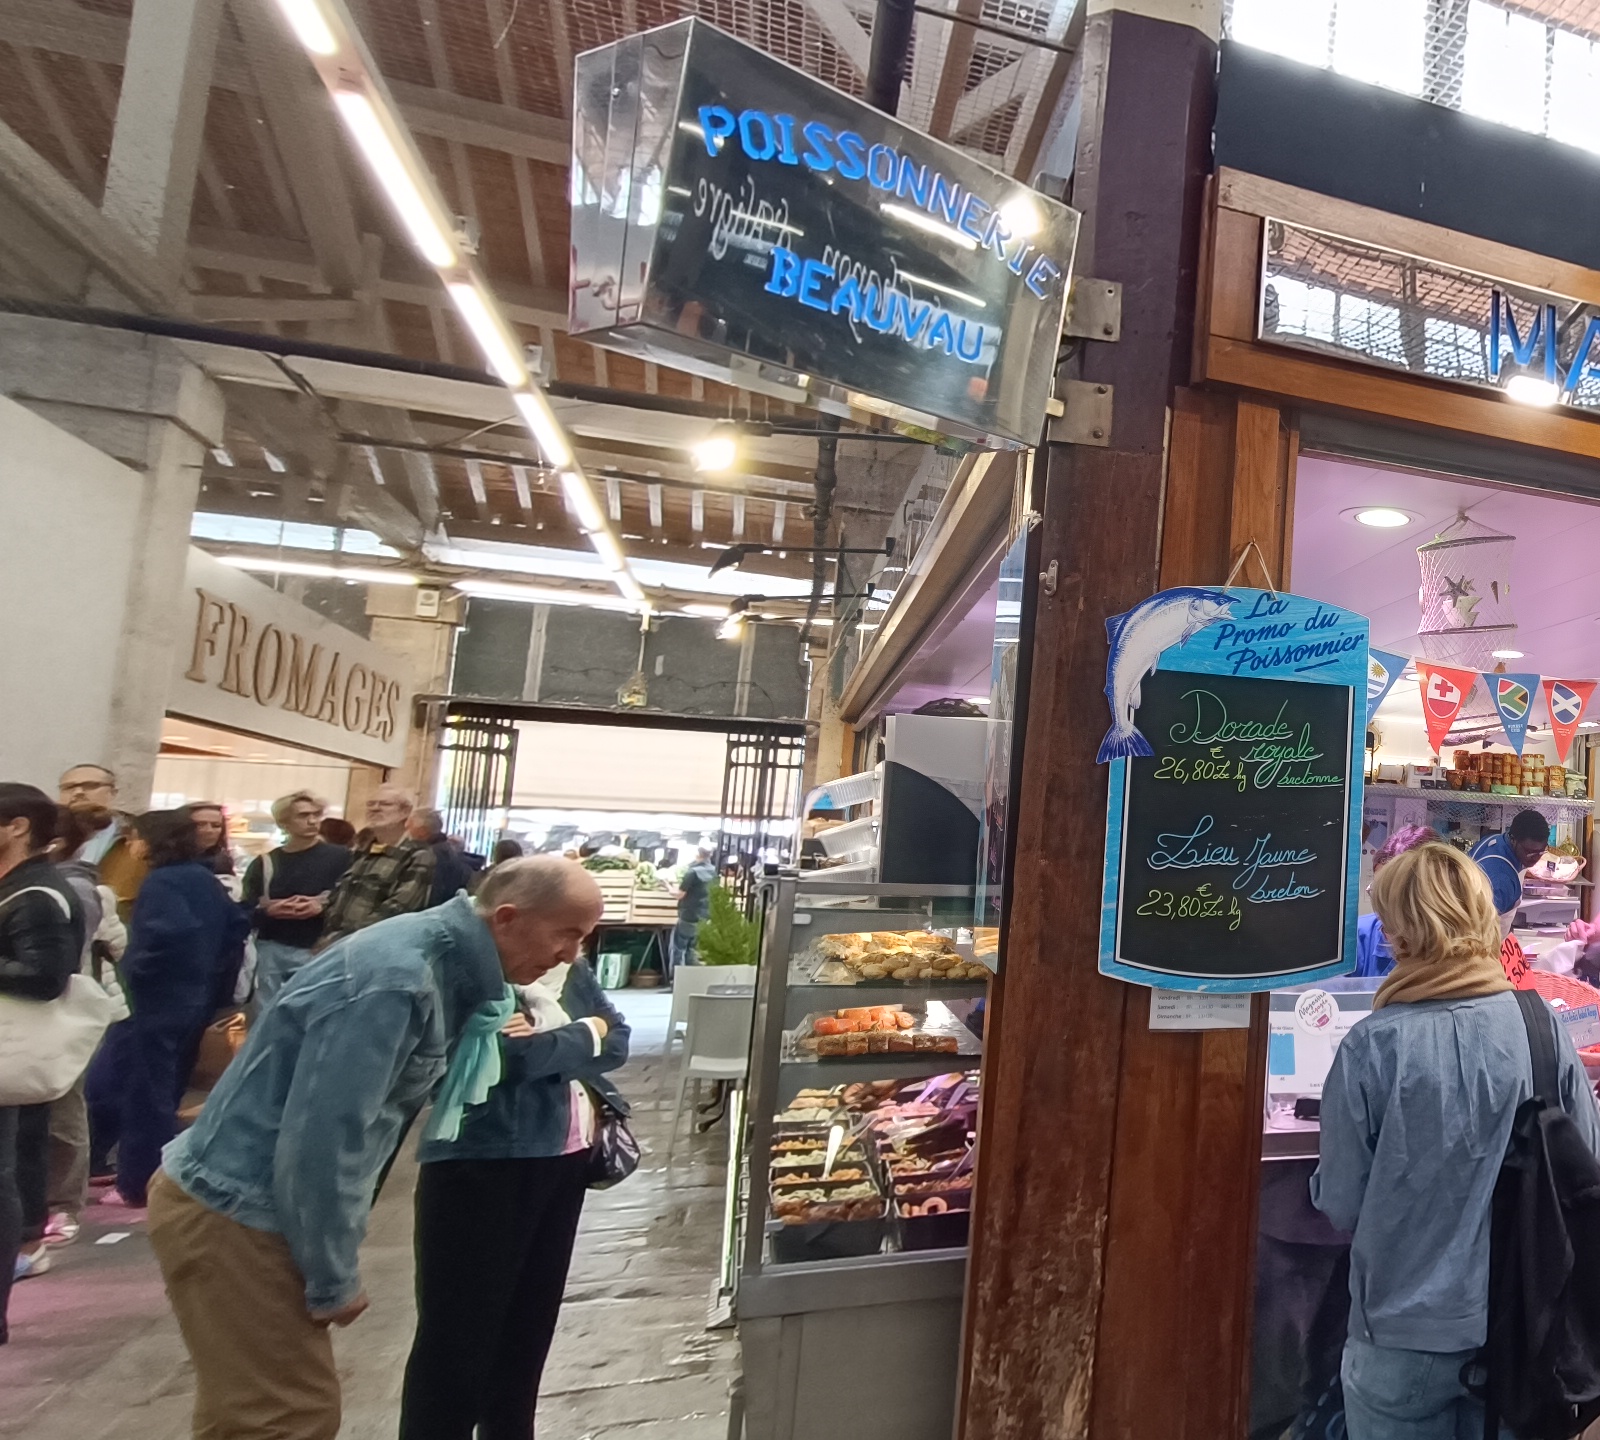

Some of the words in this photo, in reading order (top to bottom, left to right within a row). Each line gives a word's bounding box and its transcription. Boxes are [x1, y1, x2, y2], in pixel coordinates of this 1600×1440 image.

[698, 105, 1061, 301] POISSONNERIE
[765, 246, 985, 363] BEAUVAU
[1213, 621, 1297, 651] Promo
[1304, 605, 1341, 632] du
[1244, 592, 1290, 620] La
[184, 586, 402, 744] FROMAGES
[1225, 631, 1366, 676] Poissonnier
[1169, 688, 1294, 745] Dorade
[1240, 722, 1324, 790] royale
[1147, 814, 1240, 870] Lieu
[1233, 832, 1318, 890] Jaune
[1247, 871, 1326, 904] breton
